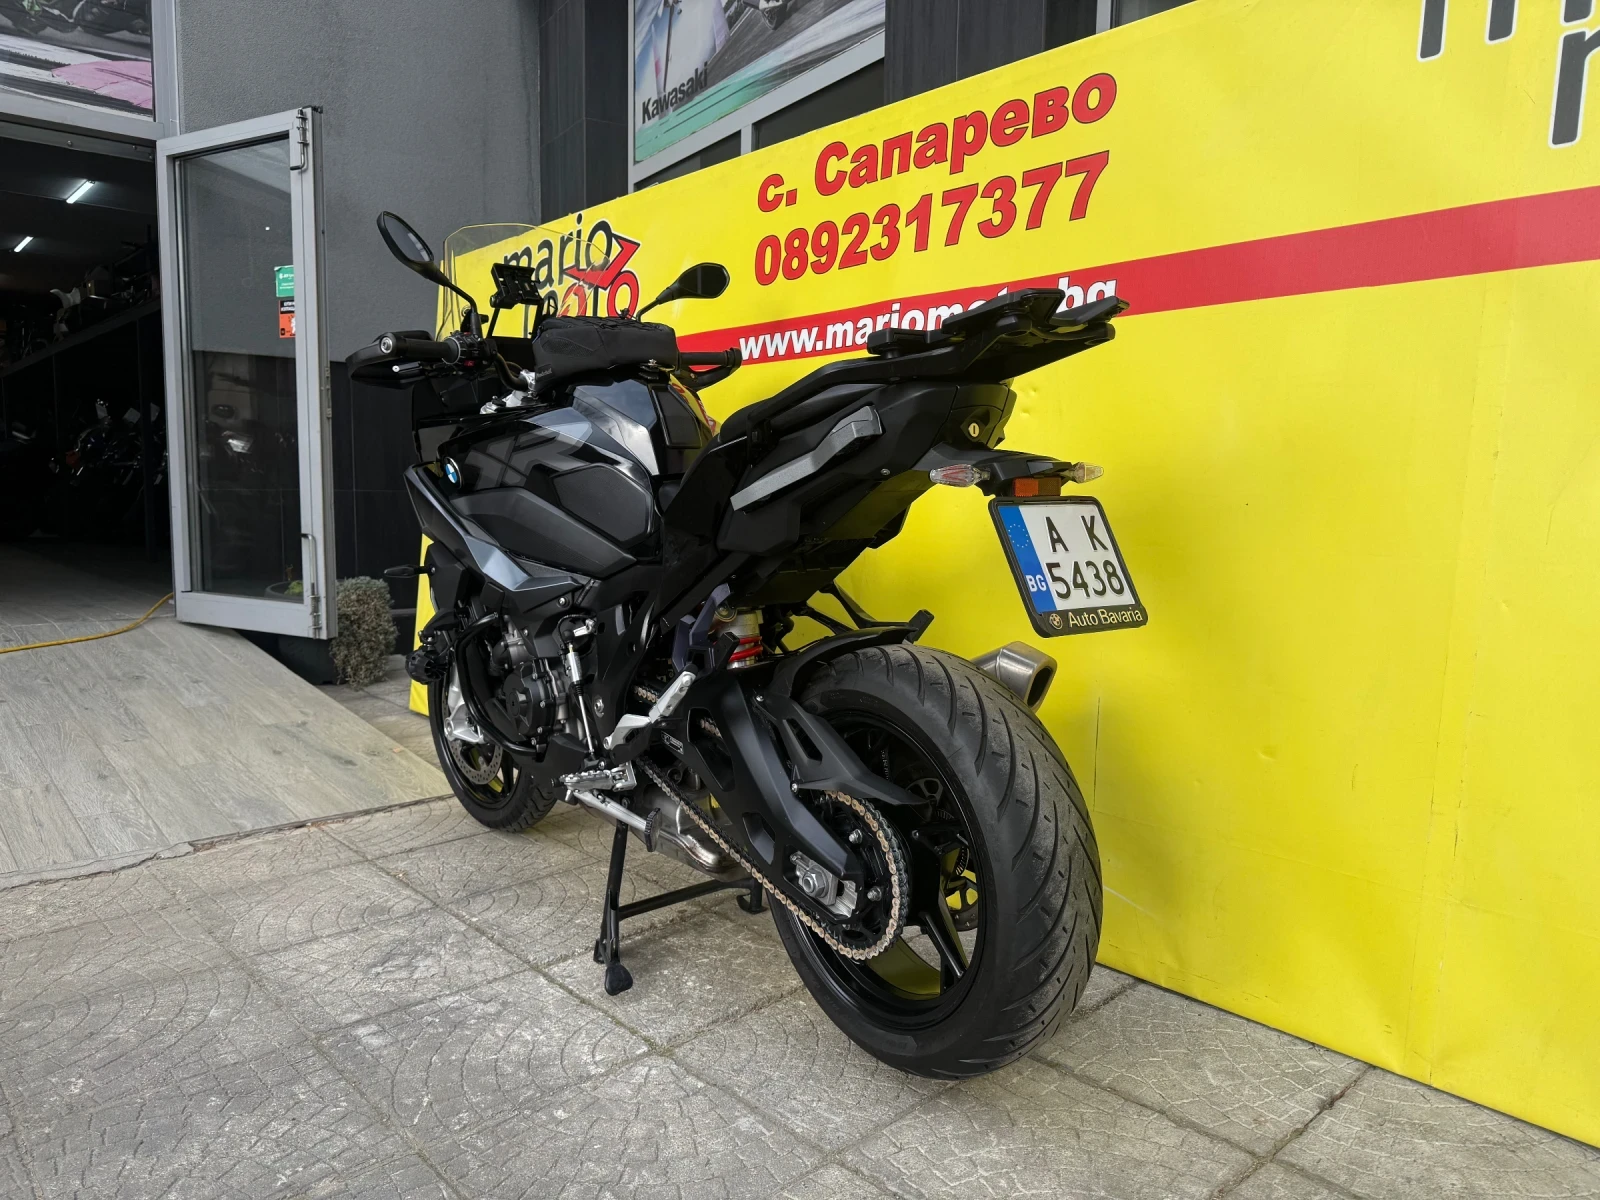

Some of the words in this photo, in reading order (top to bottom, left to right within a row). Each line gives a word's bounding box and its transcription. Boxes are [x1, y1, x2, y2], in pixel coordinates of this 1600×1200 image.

[641, 61, 708, 125] Kawasaki
[757, 173, 798, 212] с.
[814, 72, 1118, 196] Сапарево
[754, 149, 1111, 287] 0892317377
[1045, 516, 1069, 553] A
[1081, 515, 1109, 552] K
[1025, 574, 1047, 592] BG
[1045, 559, 1125, 600] 5438
[1068, 610, 1098, 628] Auto
[1098, 607, 1143, 625] Bavaria
